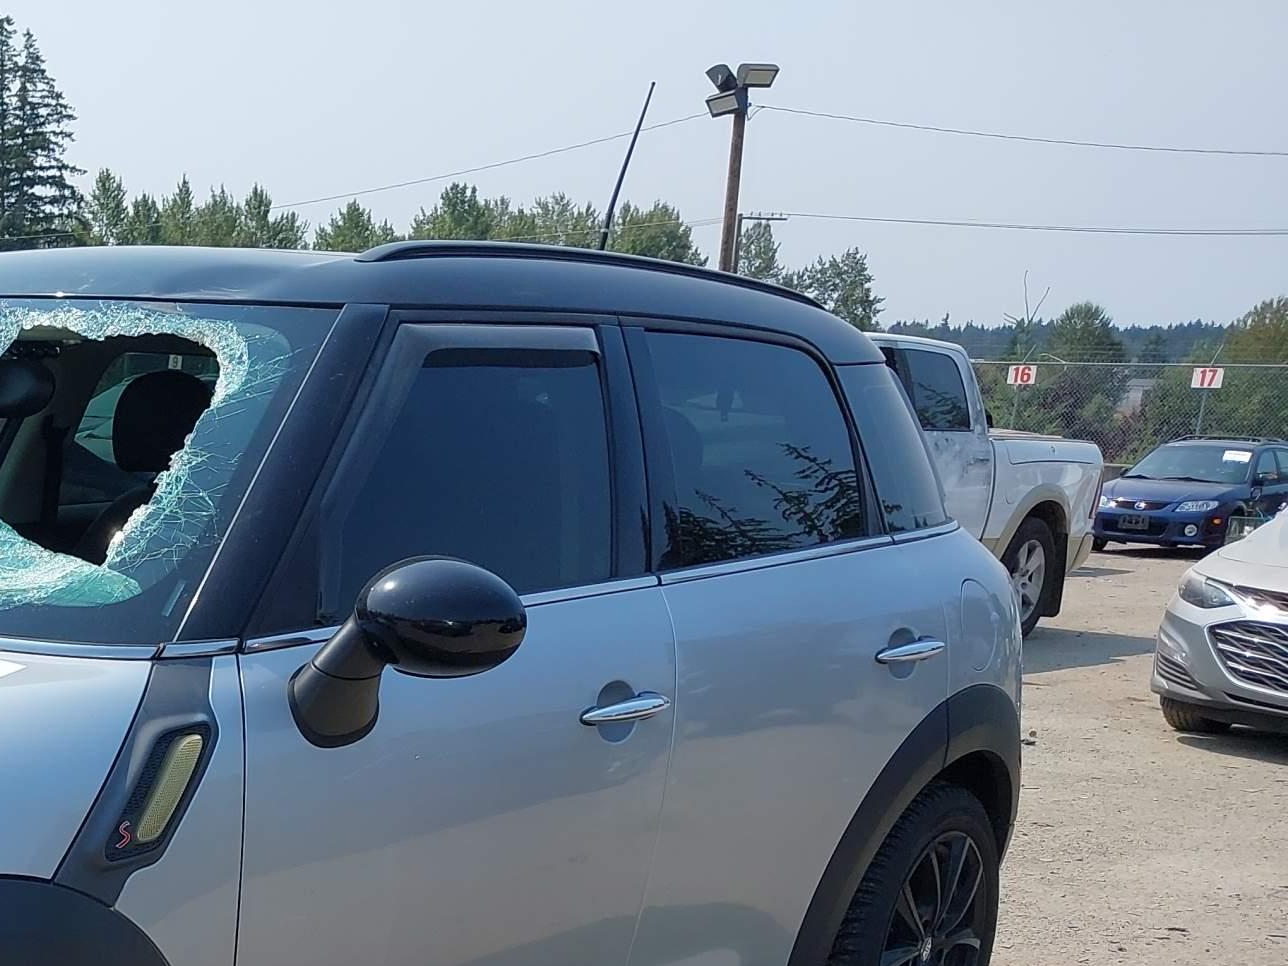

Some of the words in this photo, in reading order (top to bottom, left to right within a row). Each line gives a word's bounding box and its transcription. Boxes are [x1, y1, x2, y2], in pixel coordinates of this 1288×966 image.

[1013, 366, 1032, 384] 16
[1199, 368, 1219, 387] 17
[115, 820, 132, 849] S
